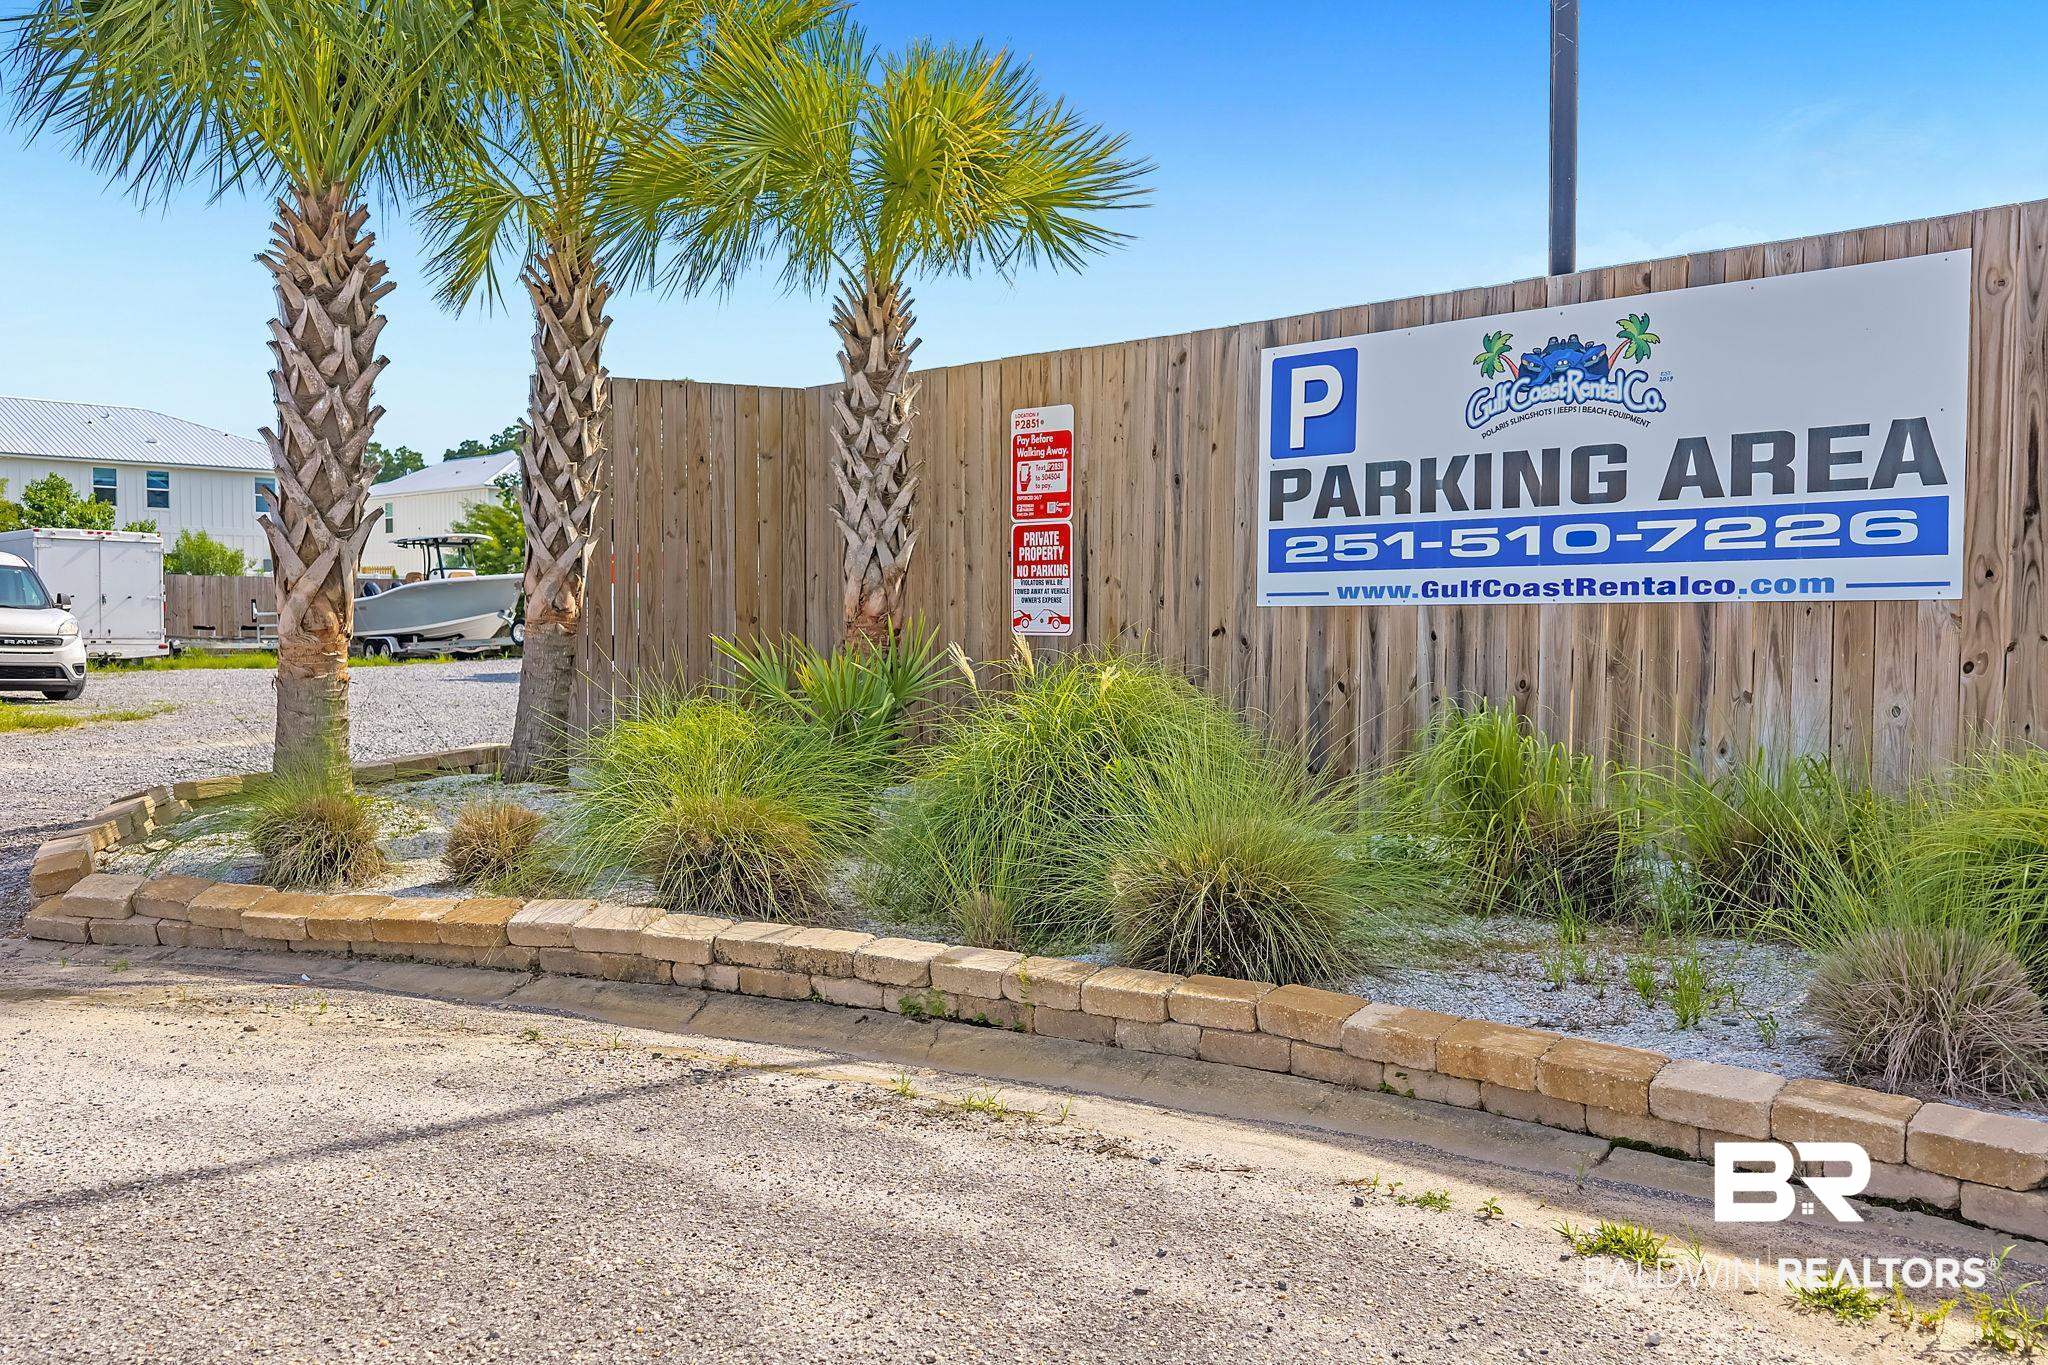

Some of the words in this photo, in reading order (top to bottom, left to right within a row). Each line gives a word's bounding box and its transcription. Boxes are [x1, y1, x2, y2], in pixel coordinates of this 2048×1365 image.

[1289, 364, 1344, 449] P
[1466, 380, 1512, 429] Gulf
[1509, 376, 1567, 412] Coast
[1564, 368, 1626, 404] Rental
[1623, 369, 1666, 413] Co.
[1015, 419, 1040, 430] P2851
[1481, 420, 1509, 439] POLARIS
[1510, 408, 1552, 426] SLINGSHOTS
[1557, 406, 1576, 414] JEEPS
[1582, 406, 1607, 415] BEACH
[1608, 409, 1651, 428] EQUIPMENT
[1016, 436, 1030, 447] Pay
[1030, 433, 1054, 444] Before
[1016, 446, 1045, 458] Walking
[1046, 446, 1069, 457] Away.
[1269, 443, 1628, 522] PARKING
[1658, 416, 1948, 501] AREA
[1023, 531, 1060, 546] PRIVATE
[1285, 510, 1918, 563] 251-510-7226
[1018, 546, 1065, 561] PROPERTY
[1016, 565, 1029, 577] NO
[1030, 564, 1069, 577] PARKING
[1337, 575, 1835, 600] www.GulfCoastRentalco.com
